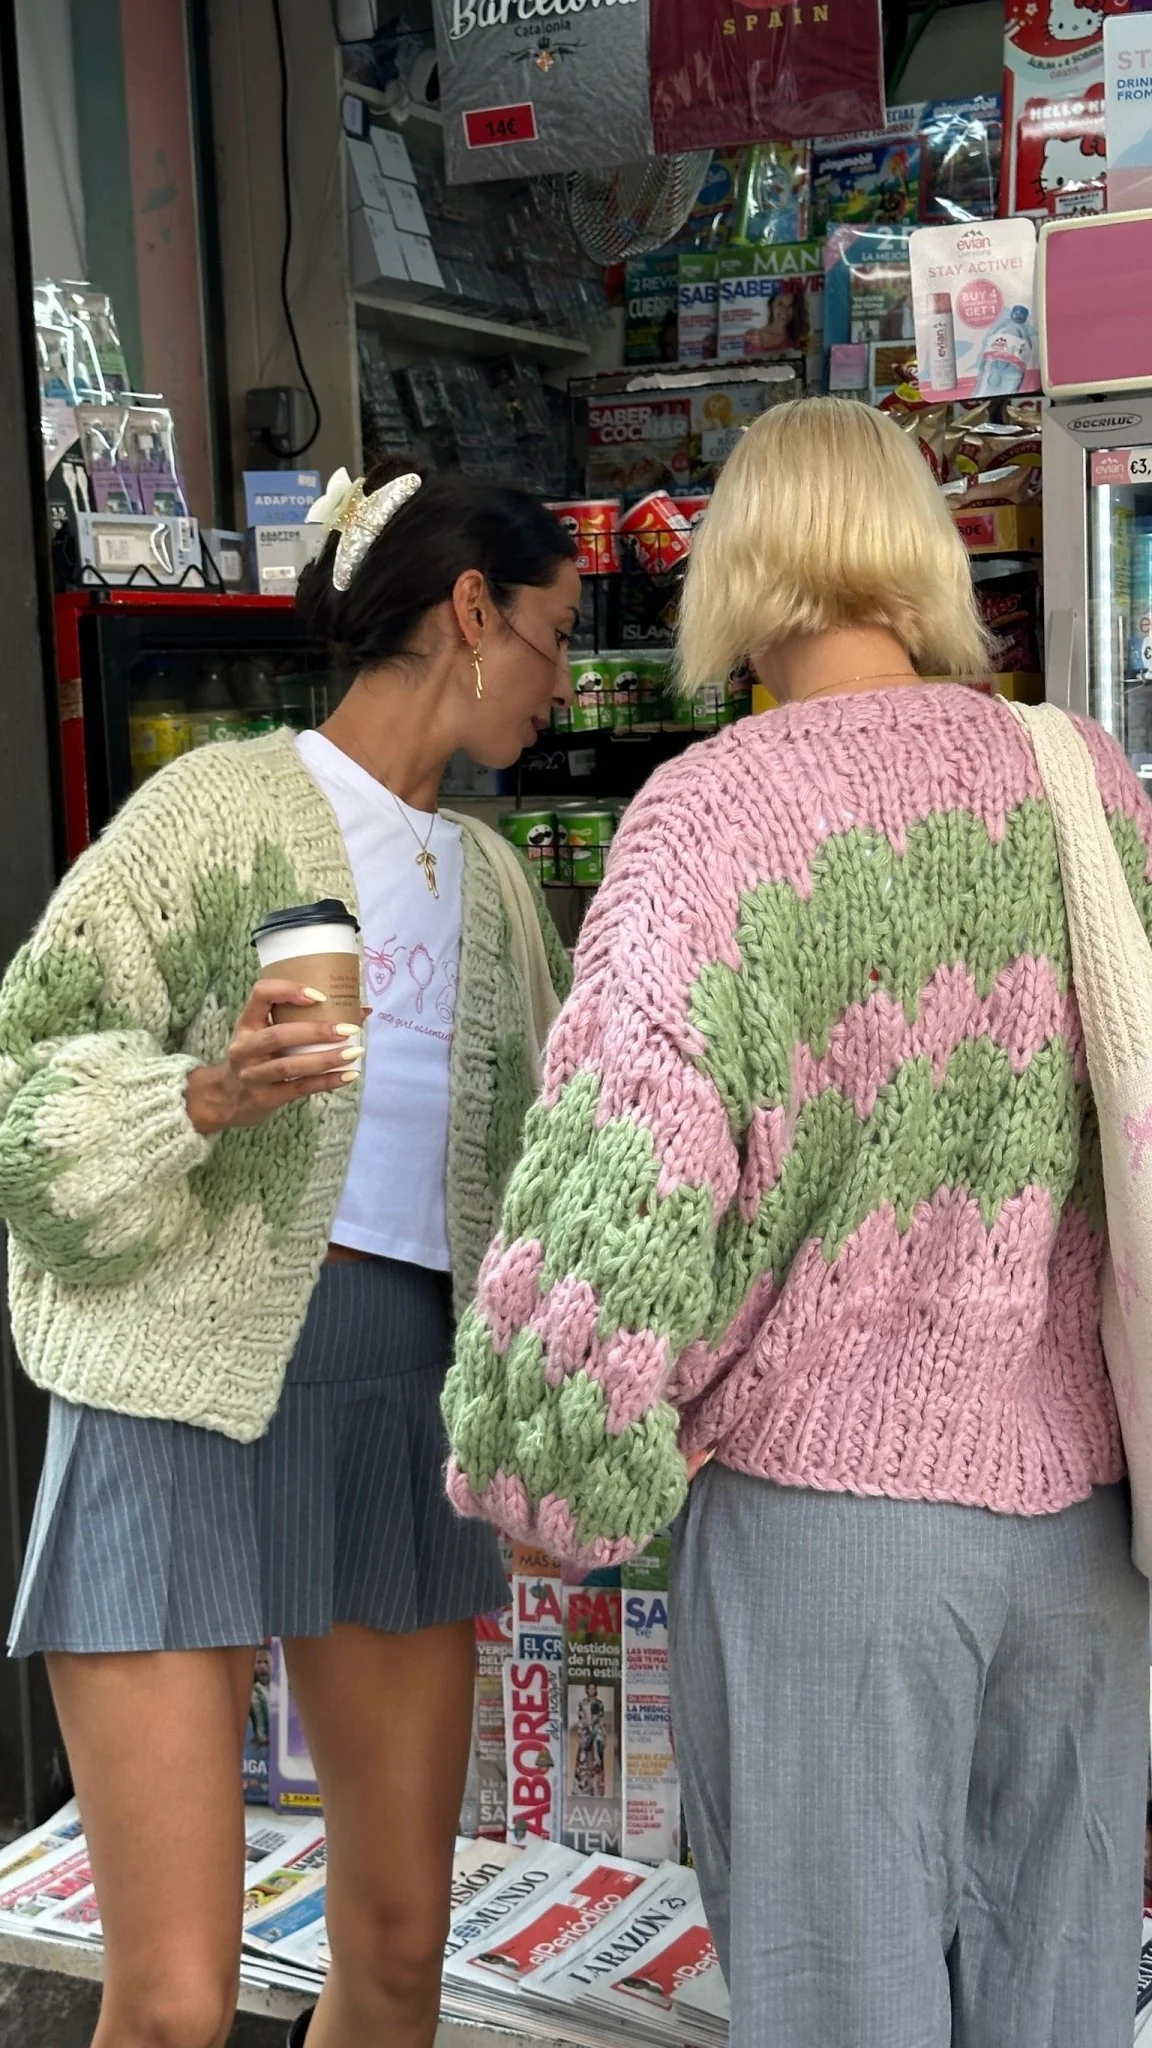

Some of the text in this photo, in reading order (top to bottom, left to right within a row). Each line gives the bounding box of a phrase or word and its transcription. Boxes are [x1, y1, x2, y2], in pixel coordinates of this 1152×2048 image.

[449, 0, 640, 40] Barce
[514, 19, 571, 38] Catalonia
[723, 5, 829, 36] SPAIN
[1029, 102, 1085, 121] HELLO
[485, 121, 518, 137] 14€
[877, 226, 894, 250] 2
[956, 236, 992, 251] evian
[927, 256, 1023, 279] STAY ACTIVE!
[720, 279, 781, 301] SABER
[962, 287, 998, 303] BUY 4
[964, 307, 986, 318] GET
[937, 329, 947, 358] evian
[588, 406, 652, 428] SABER
[600, 420, 688, 443] COCINAR
[1095, 464, 1124, 475] evian
[255, 496, 314, 505] ADAPTOR
[395, 1017, 413, 1031] girl
[518, 1583, 562, 1625] LA
[524, 1637, 540, 1652] EL
[568, 1641, 620, 1656] Vestidos
[568, 1653, 619, 1667] de firma
[568, 1667, 591, 1677] con
[512, 1663, 551, 1849] ABORES
[242, 1759, 268, 1775] IGA
[465, 1871, 549, 1929] MUNDO
